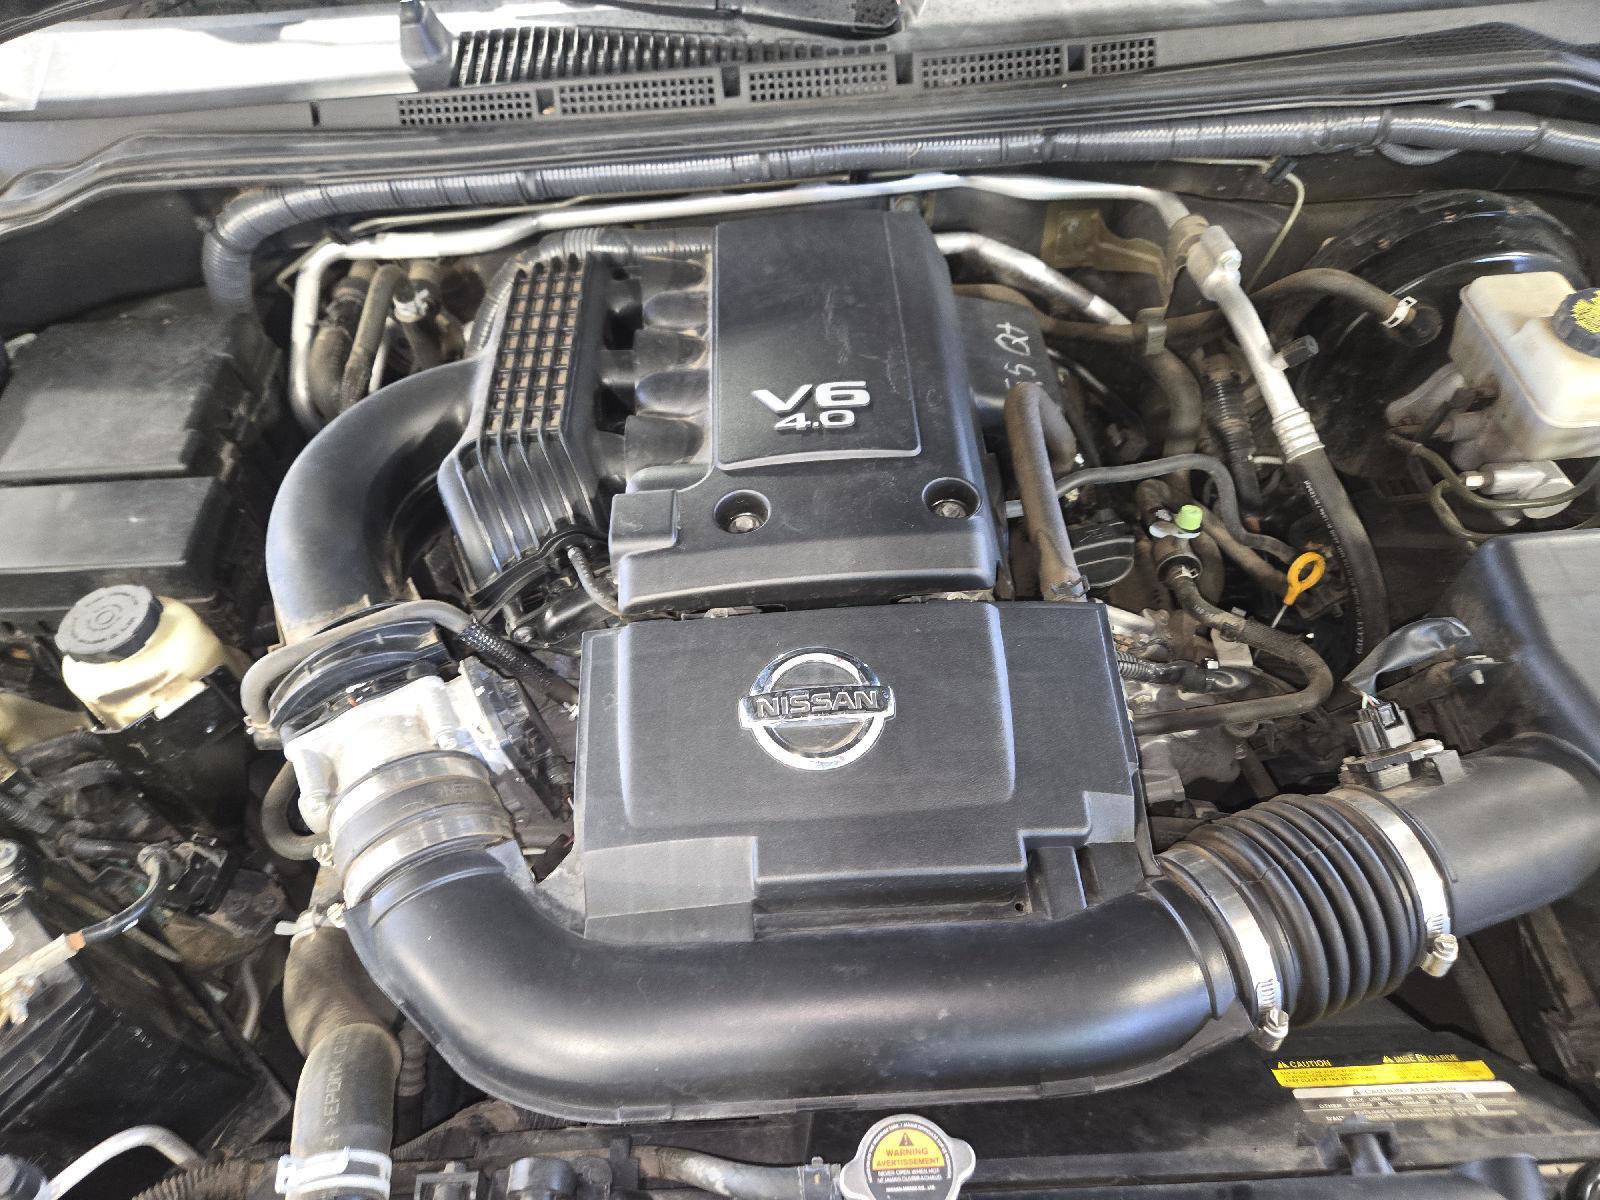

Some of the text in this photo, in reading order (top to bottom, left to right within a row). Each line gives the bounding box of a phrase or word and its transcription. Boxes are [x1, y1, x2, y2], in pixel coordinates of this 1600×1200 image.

[751, 380, 871, 414] V6
[774, 409, 855, 431] 4.0
[756, 690, 879, 718] NISSAN
[1289, 1059, 1332, 1069] CAUTION
[885, 1147, 929, 1157] WARNING
[876, 1157, 940, 1168] AVERTISSEMENT
